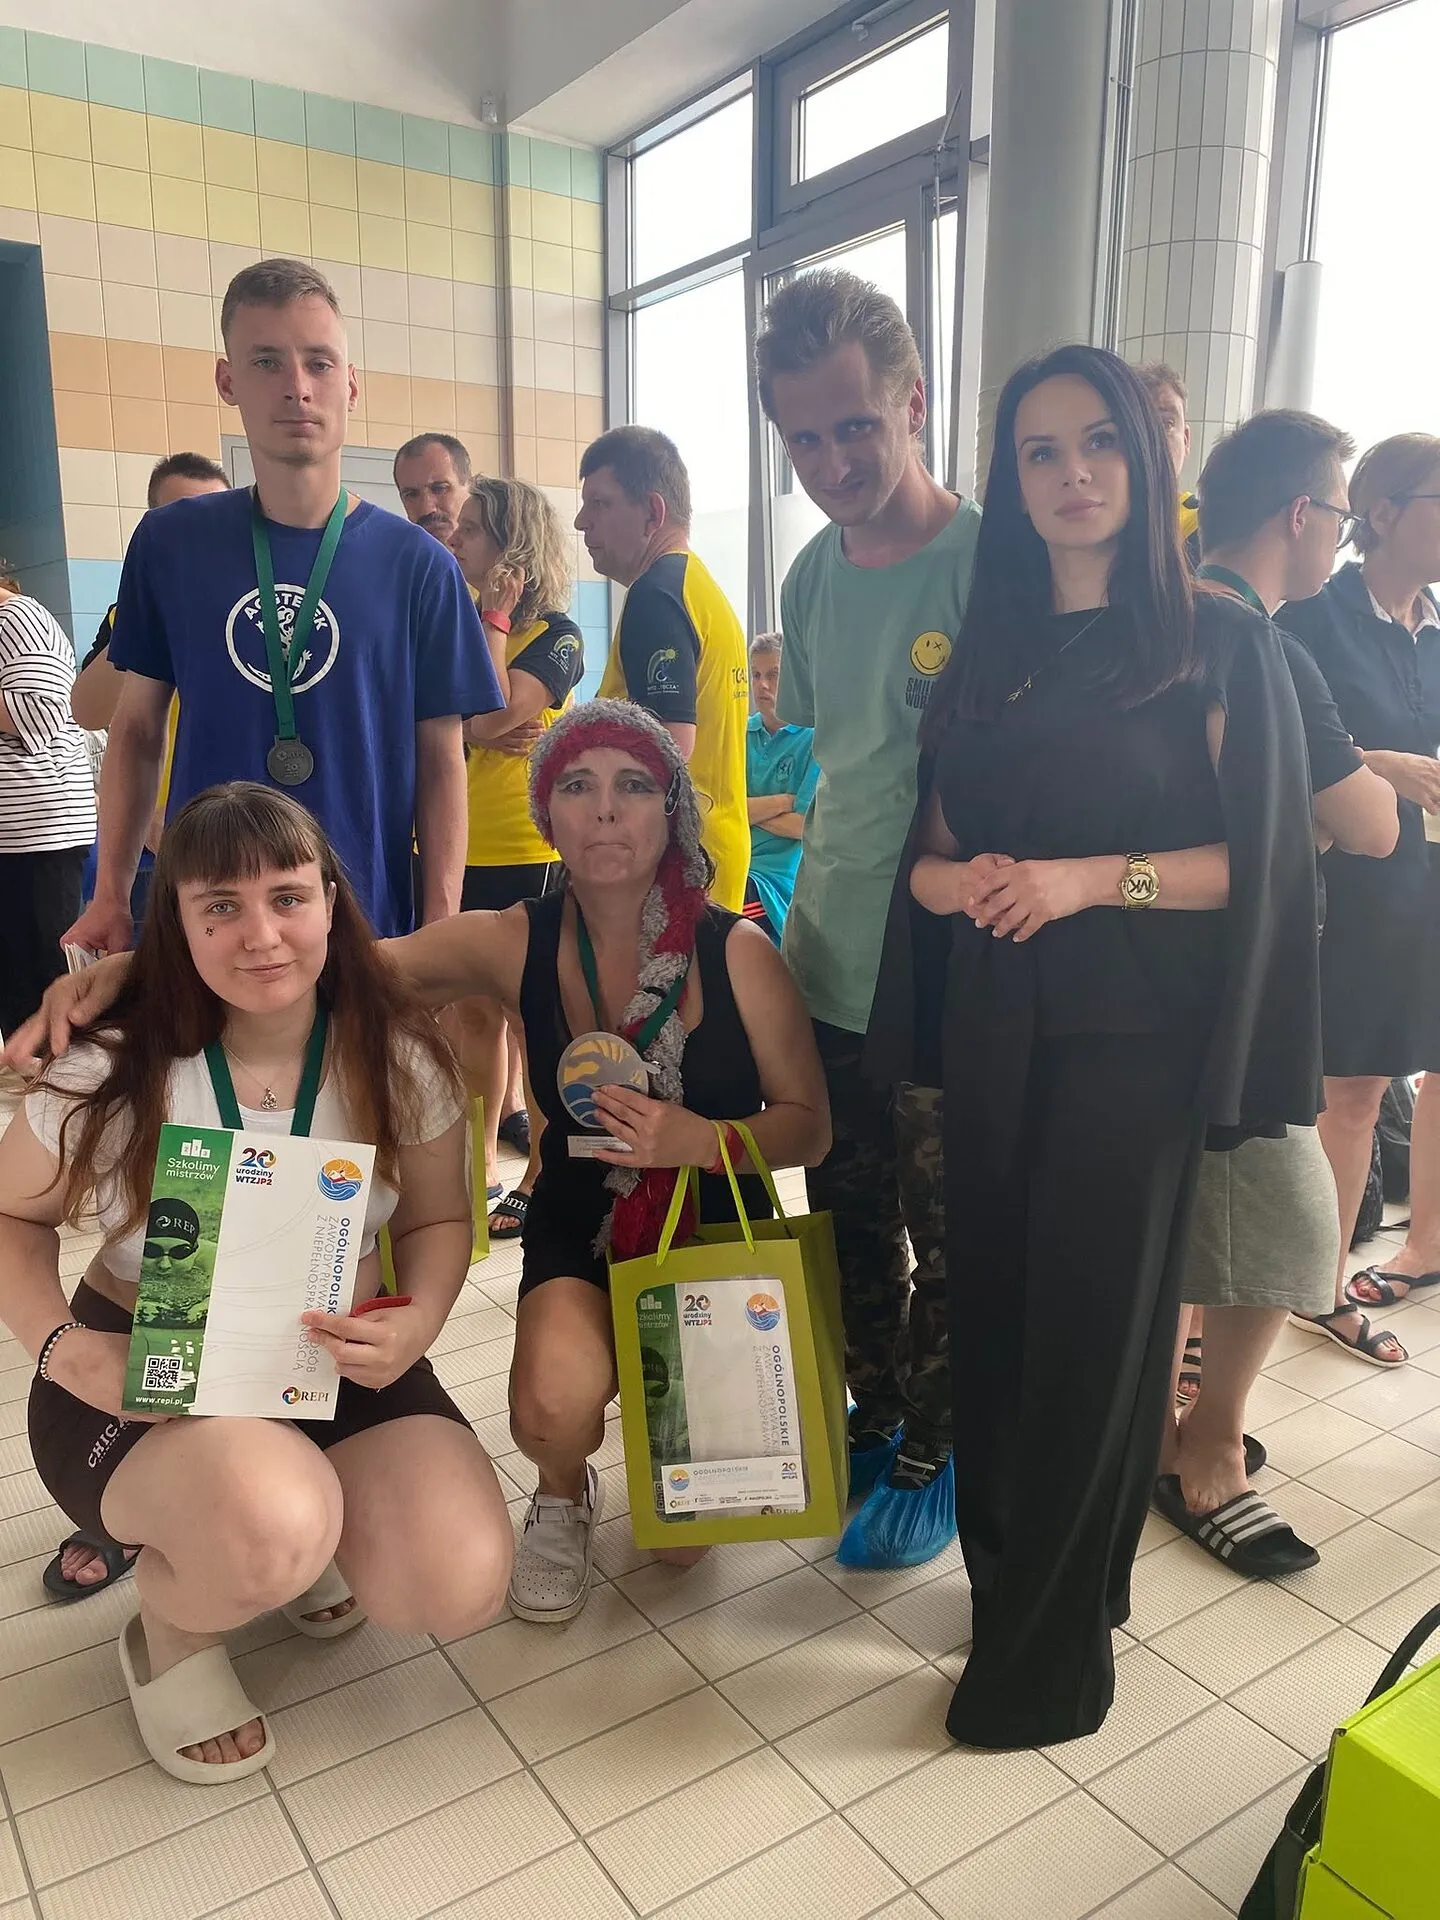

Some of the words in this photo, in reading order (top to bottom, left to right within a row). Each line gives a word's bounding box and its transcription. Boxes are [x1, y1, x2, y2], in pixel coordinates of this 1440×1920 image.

[168, 1157, 220, 1174] Szkolimy
[238, 1147, 277, 1168] 20
[166, 1169, 214, 1180] mistrzów
[235, 1175, 273, 1186] WTZJP2
[236, 1167, 273, 1178] urodziny
[317, 1214, 327, 1222] Z
[322, 1215, 340, 1269] ZAWODY
[326, 1217, 351, 1315] OGÓLNOPOLSK
[684, 1294, 711, 1312] 20
[135, 1396, 183, 1406] www.repi.pl
[301, 1391, 329, 1402] REPI
[772, 1345, 790, 1446] OGÓLNOPOLSKIE
[755, 1356, 772, 1457] NIEPEŁNOSPRAWN
